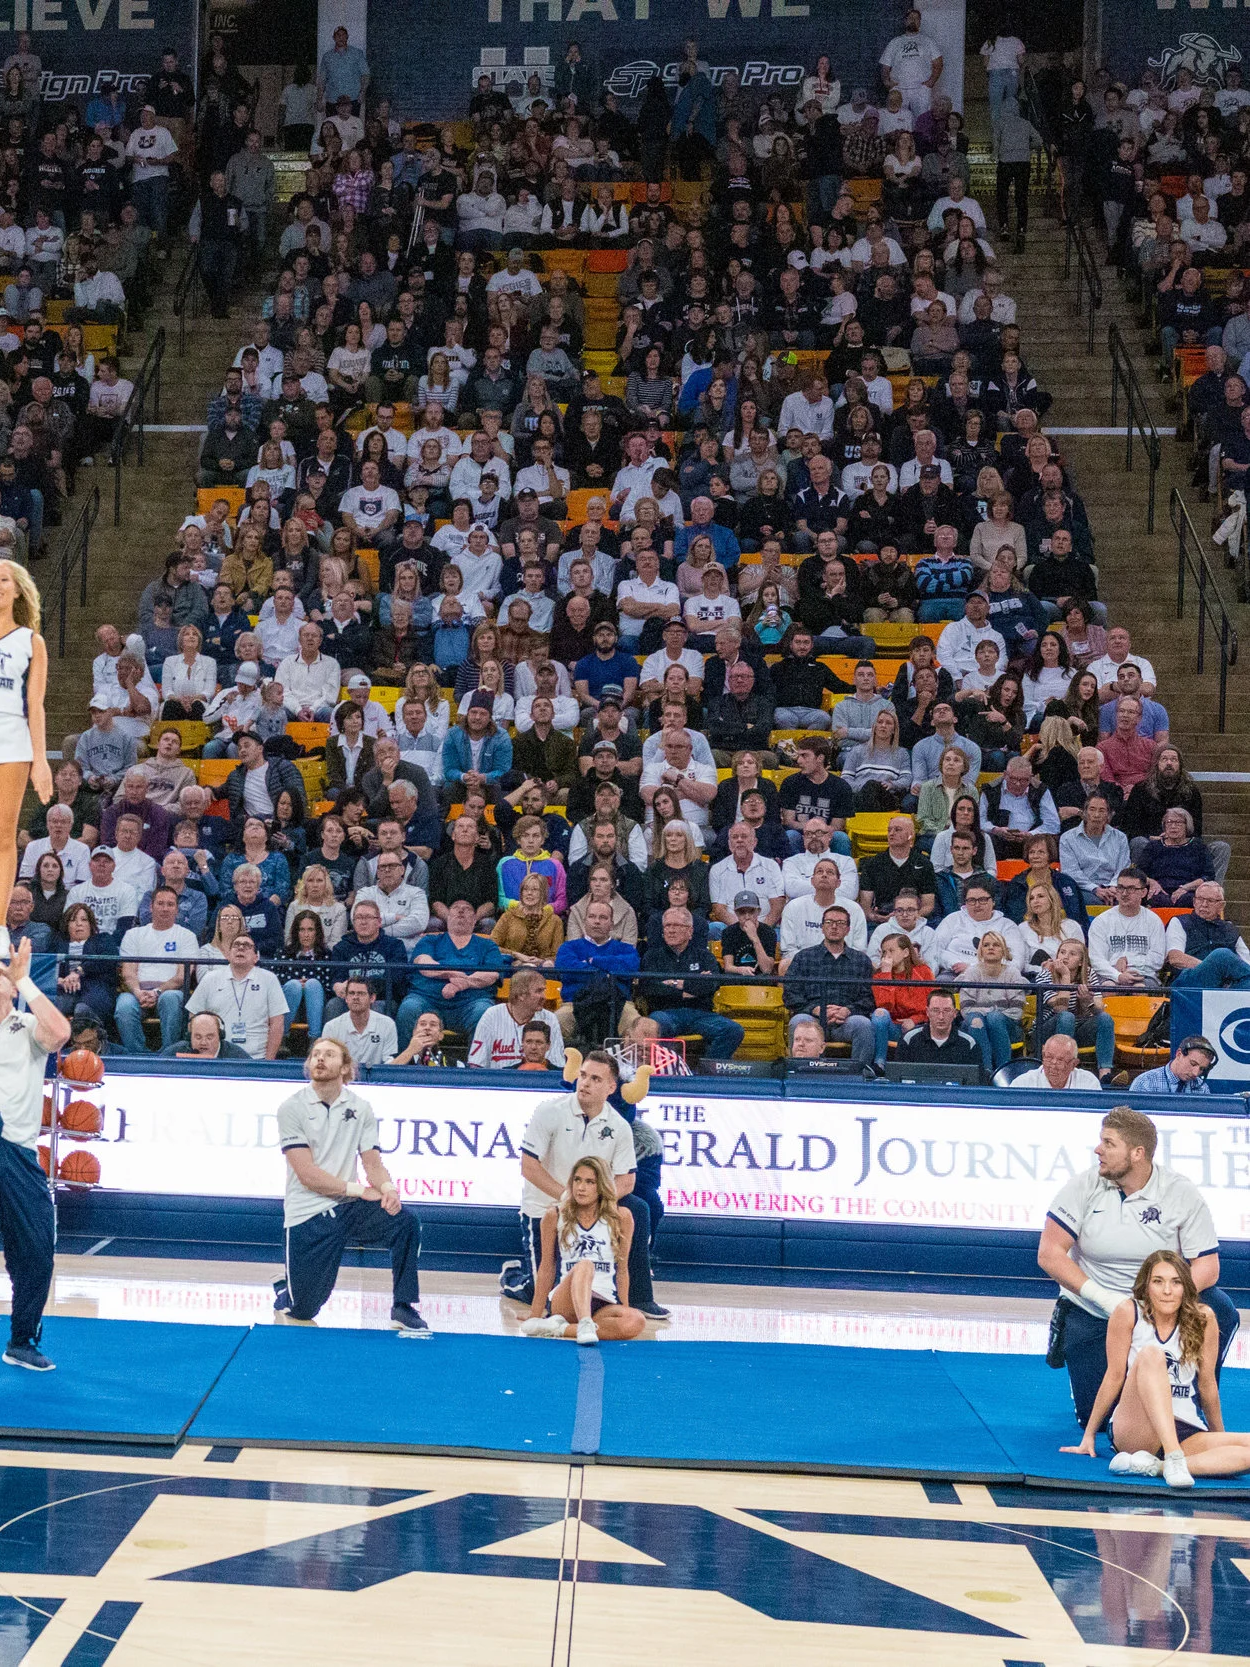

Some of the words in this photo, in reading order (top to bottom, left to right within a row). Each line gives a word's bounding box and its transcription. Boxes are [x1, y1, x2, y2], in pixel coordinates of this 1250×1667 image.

[741, 61, 805, 86] Pro
[39, 73, 89, 101] ign
[844, 445, 862, 459] US
[795, 803, 832, 817] STATE
[469, 1040, 483, 1056] 7
[491, 1040, 516, 1055] Mud
[658, 1104, 706, 1123] THE
[377, 1116, 523, 1161] URNA
[661, 1128, 838, 1173] ERALD
[854, 1116, 1078, 1188] JOURNA
[667, 1189, 825, 1214] EMPOWERING
[831, 1196, 877, 1217] THE
[883, 1198, 1035, 1223] COMMUNITY
[1170, 1384, 1190, 1399] TATE
